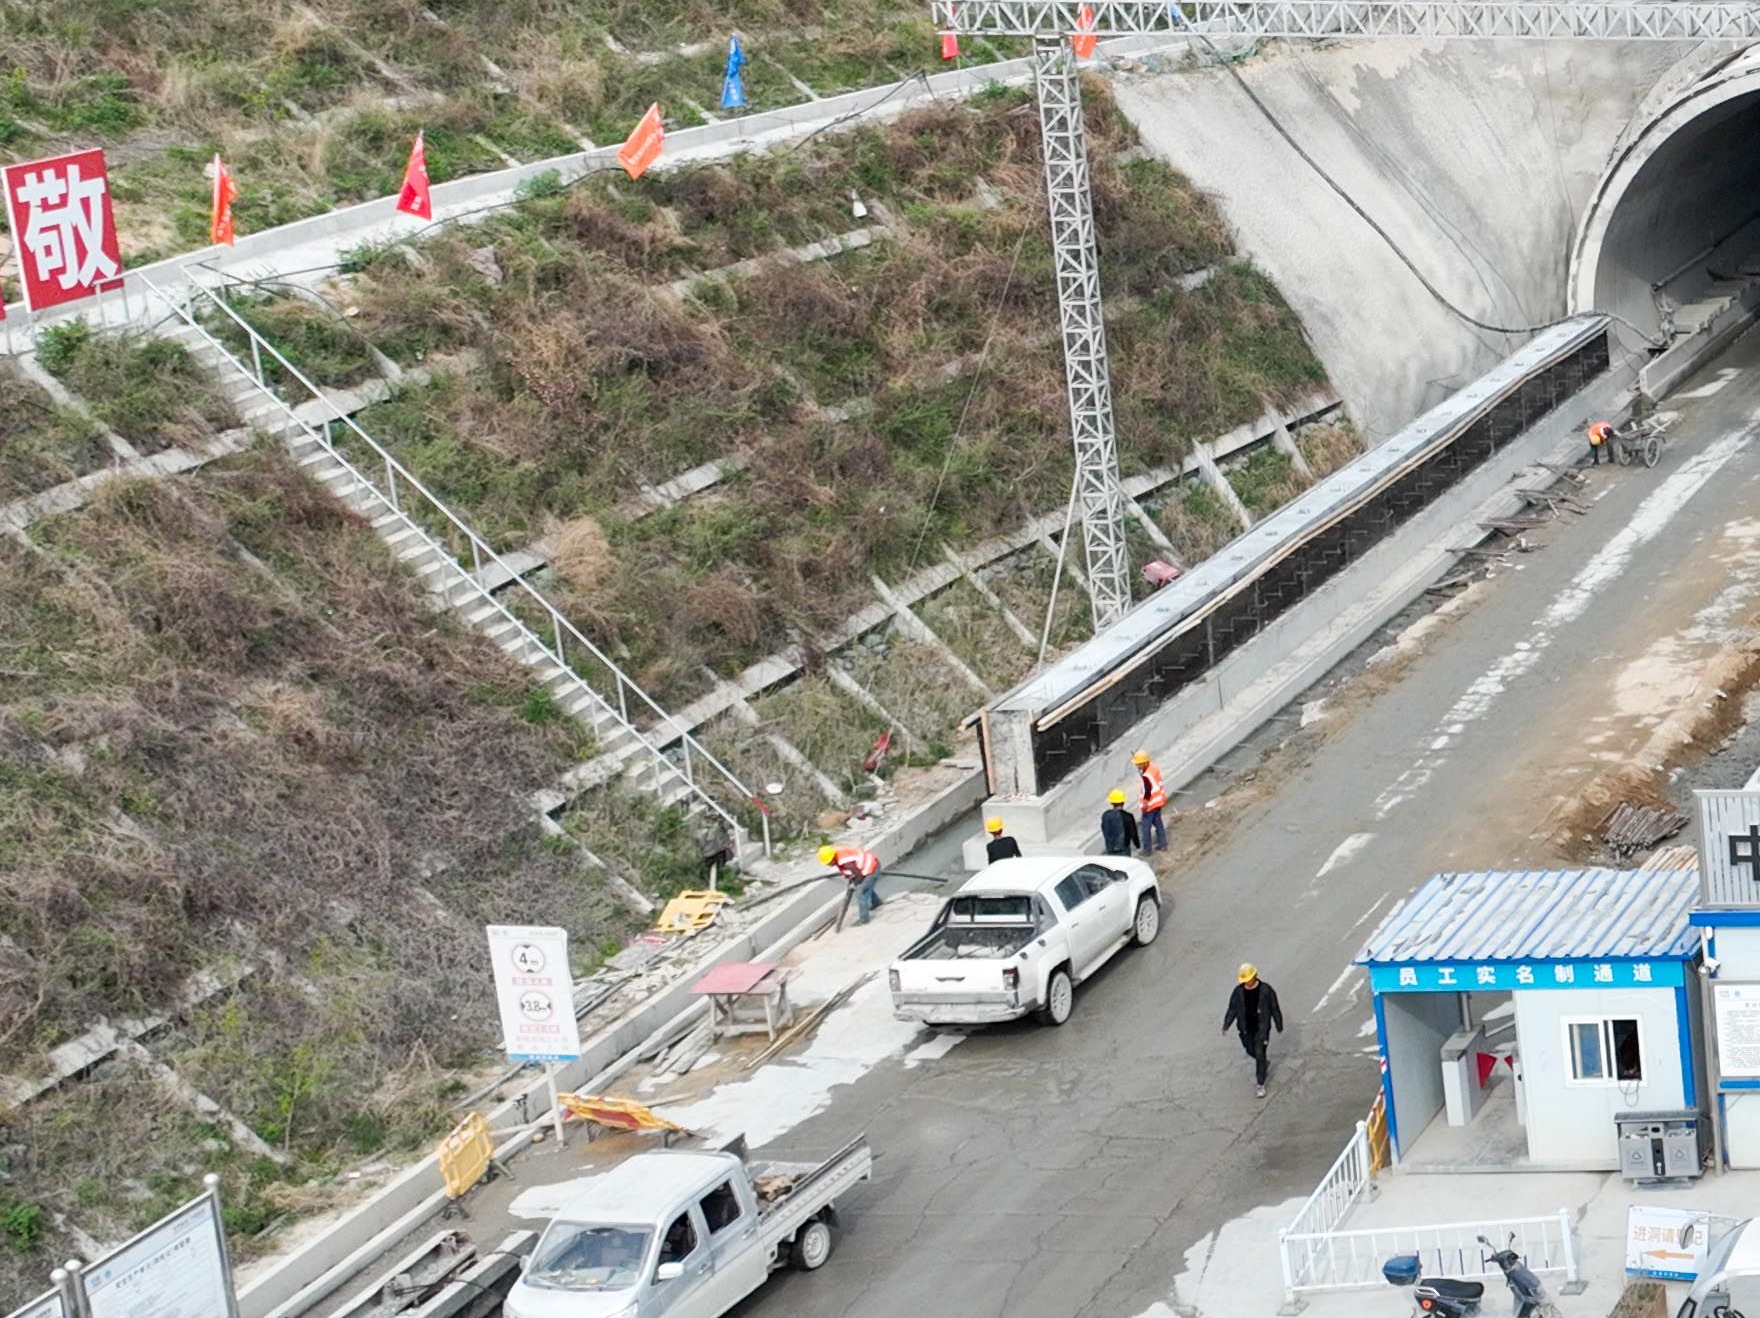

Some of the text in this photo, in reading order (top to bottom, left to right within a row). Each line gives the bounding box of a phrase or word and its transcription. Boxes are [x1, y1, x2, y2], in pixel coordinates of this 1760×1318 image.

[16, 164, 118, 290] 敬
[1399, 964, 1652, 986] 员工实名制通道
[1633, 1225, 1704, 1246] 进洞请记
